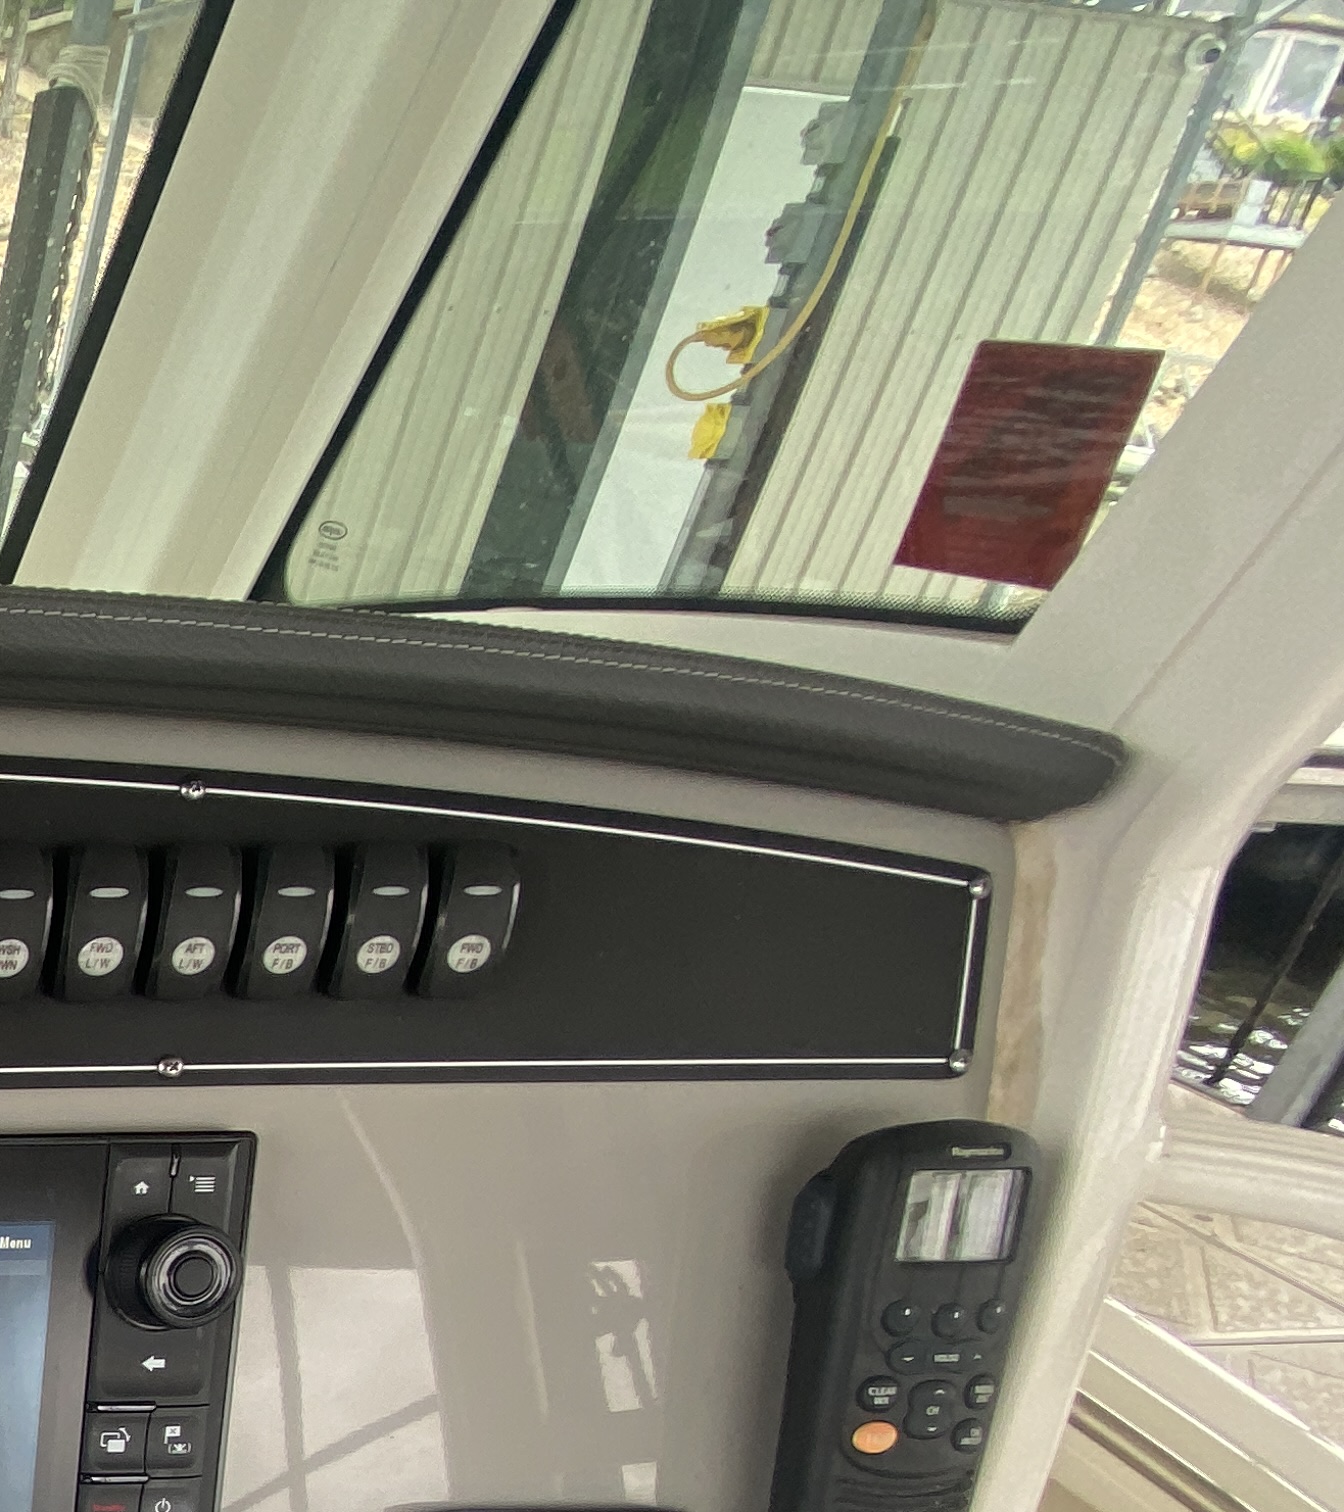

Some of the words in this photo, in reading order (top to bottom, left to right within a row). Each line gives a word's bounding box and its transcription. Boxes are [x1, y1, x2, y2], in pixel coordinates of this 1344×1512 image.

[89, 942, 115, 954] FWD
[184, 943, 207, 955] AFT
[271, 942, 302, 955] PORT
[459, 942, 483, 954] FWD
